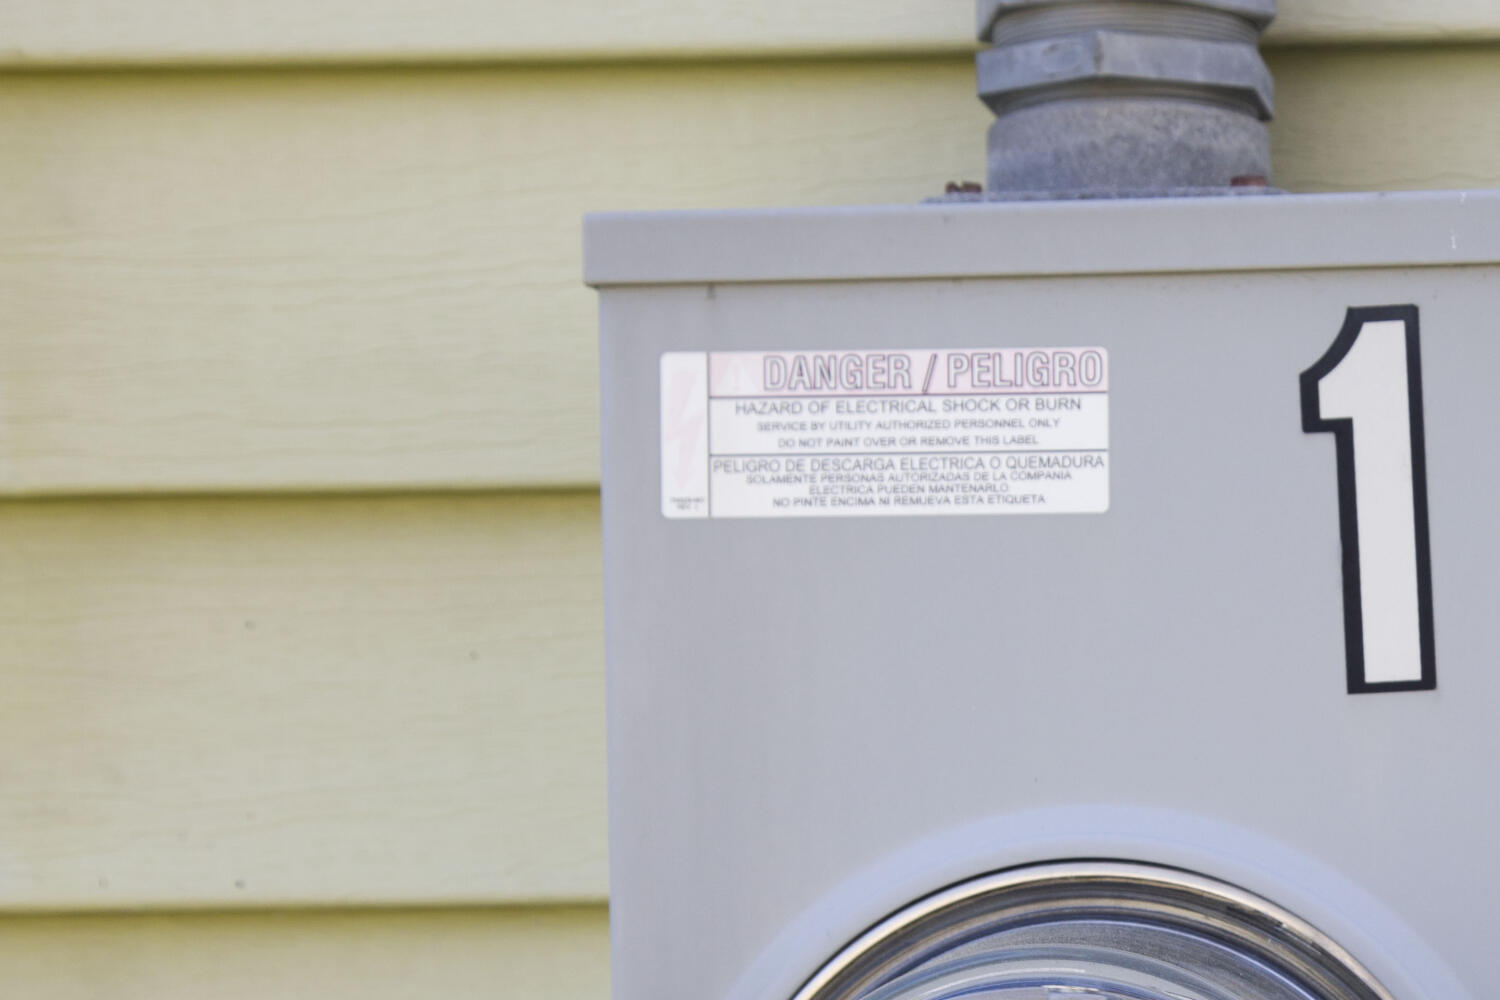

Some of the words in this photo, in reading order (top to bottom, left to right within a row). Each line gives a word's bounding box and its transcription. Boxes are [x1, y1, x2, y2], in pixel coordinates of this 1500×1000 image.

[762, 353, 912, 391] DANGER
[946, 350, 1105, 389] PELIGRO
[735, 400, 803, 415] HAZARD
[807, 399, 830, 414] OF
[835, 399, 936, 414] ELECTRICAL
[942, 397, 1001, 412] SHOCK
[1004, 397, 1030, 411] OR
[1034, 396, 1081, 411] BURN
[711, 458, 781, 473] PELIGRO
[784, 458, 805, 473] DE
[810, 457, 895, 472] DESCARGA
[899, 456, 986, 471] ELECTRICA
[989, 455, 1002, 470] O
[1005, 455, 1104, 470] QUEMADURA
[1299, 304, 1437, 694] 1
